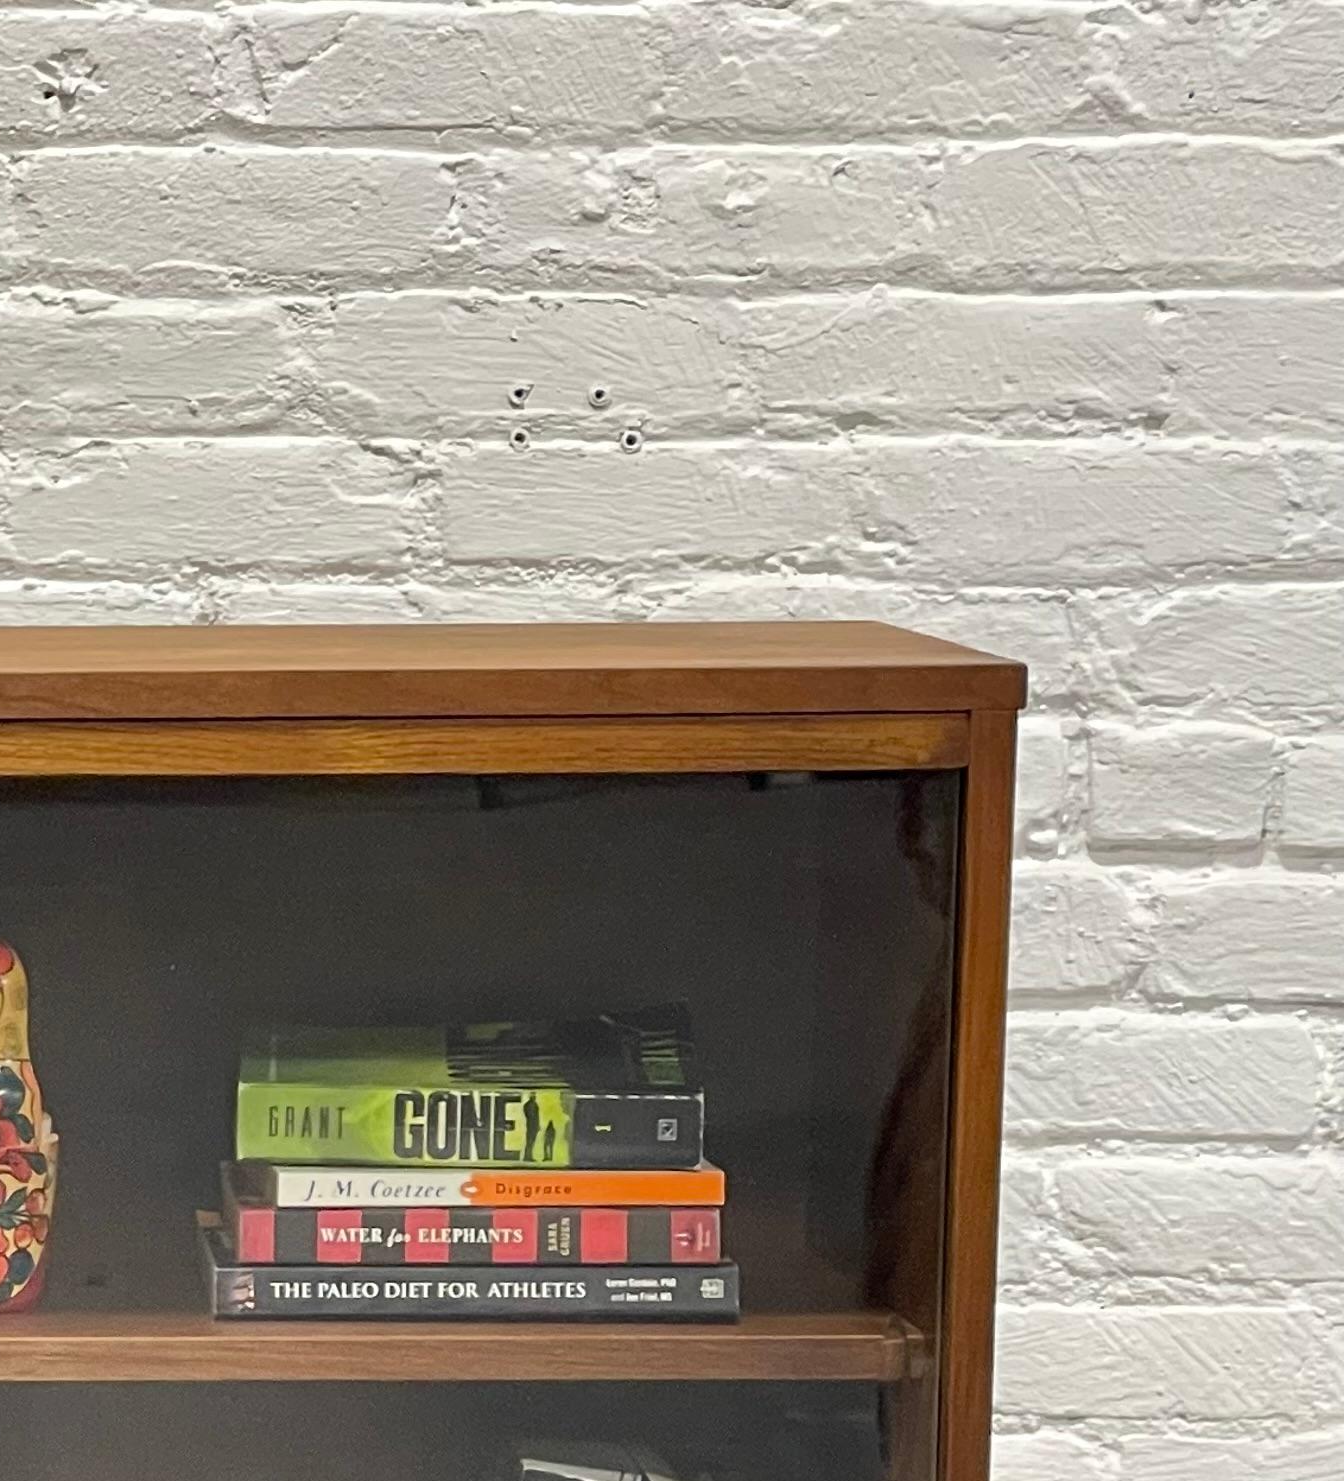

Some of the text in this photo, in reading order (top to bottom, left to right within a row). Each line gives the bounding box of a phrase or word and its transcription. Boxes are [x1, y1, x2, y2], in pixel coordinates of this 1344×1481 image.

[268, 1104, 347, 1141] GRANT
[393, 1089, 523, 1161] GONE
[304, 1177, 447, 1202] J. M. Coetzee
[495, 1182, 573, 1198] Disgrace
[320, 1227, 524, 1248] WATER for ELEPHANTS
[548, 1222, 558, 1252] SARA
[559, 1216, 571, 1257] GRUEN
[269, 1281, 587, 1299] THE PALEO DIET FOR ATHLETES
